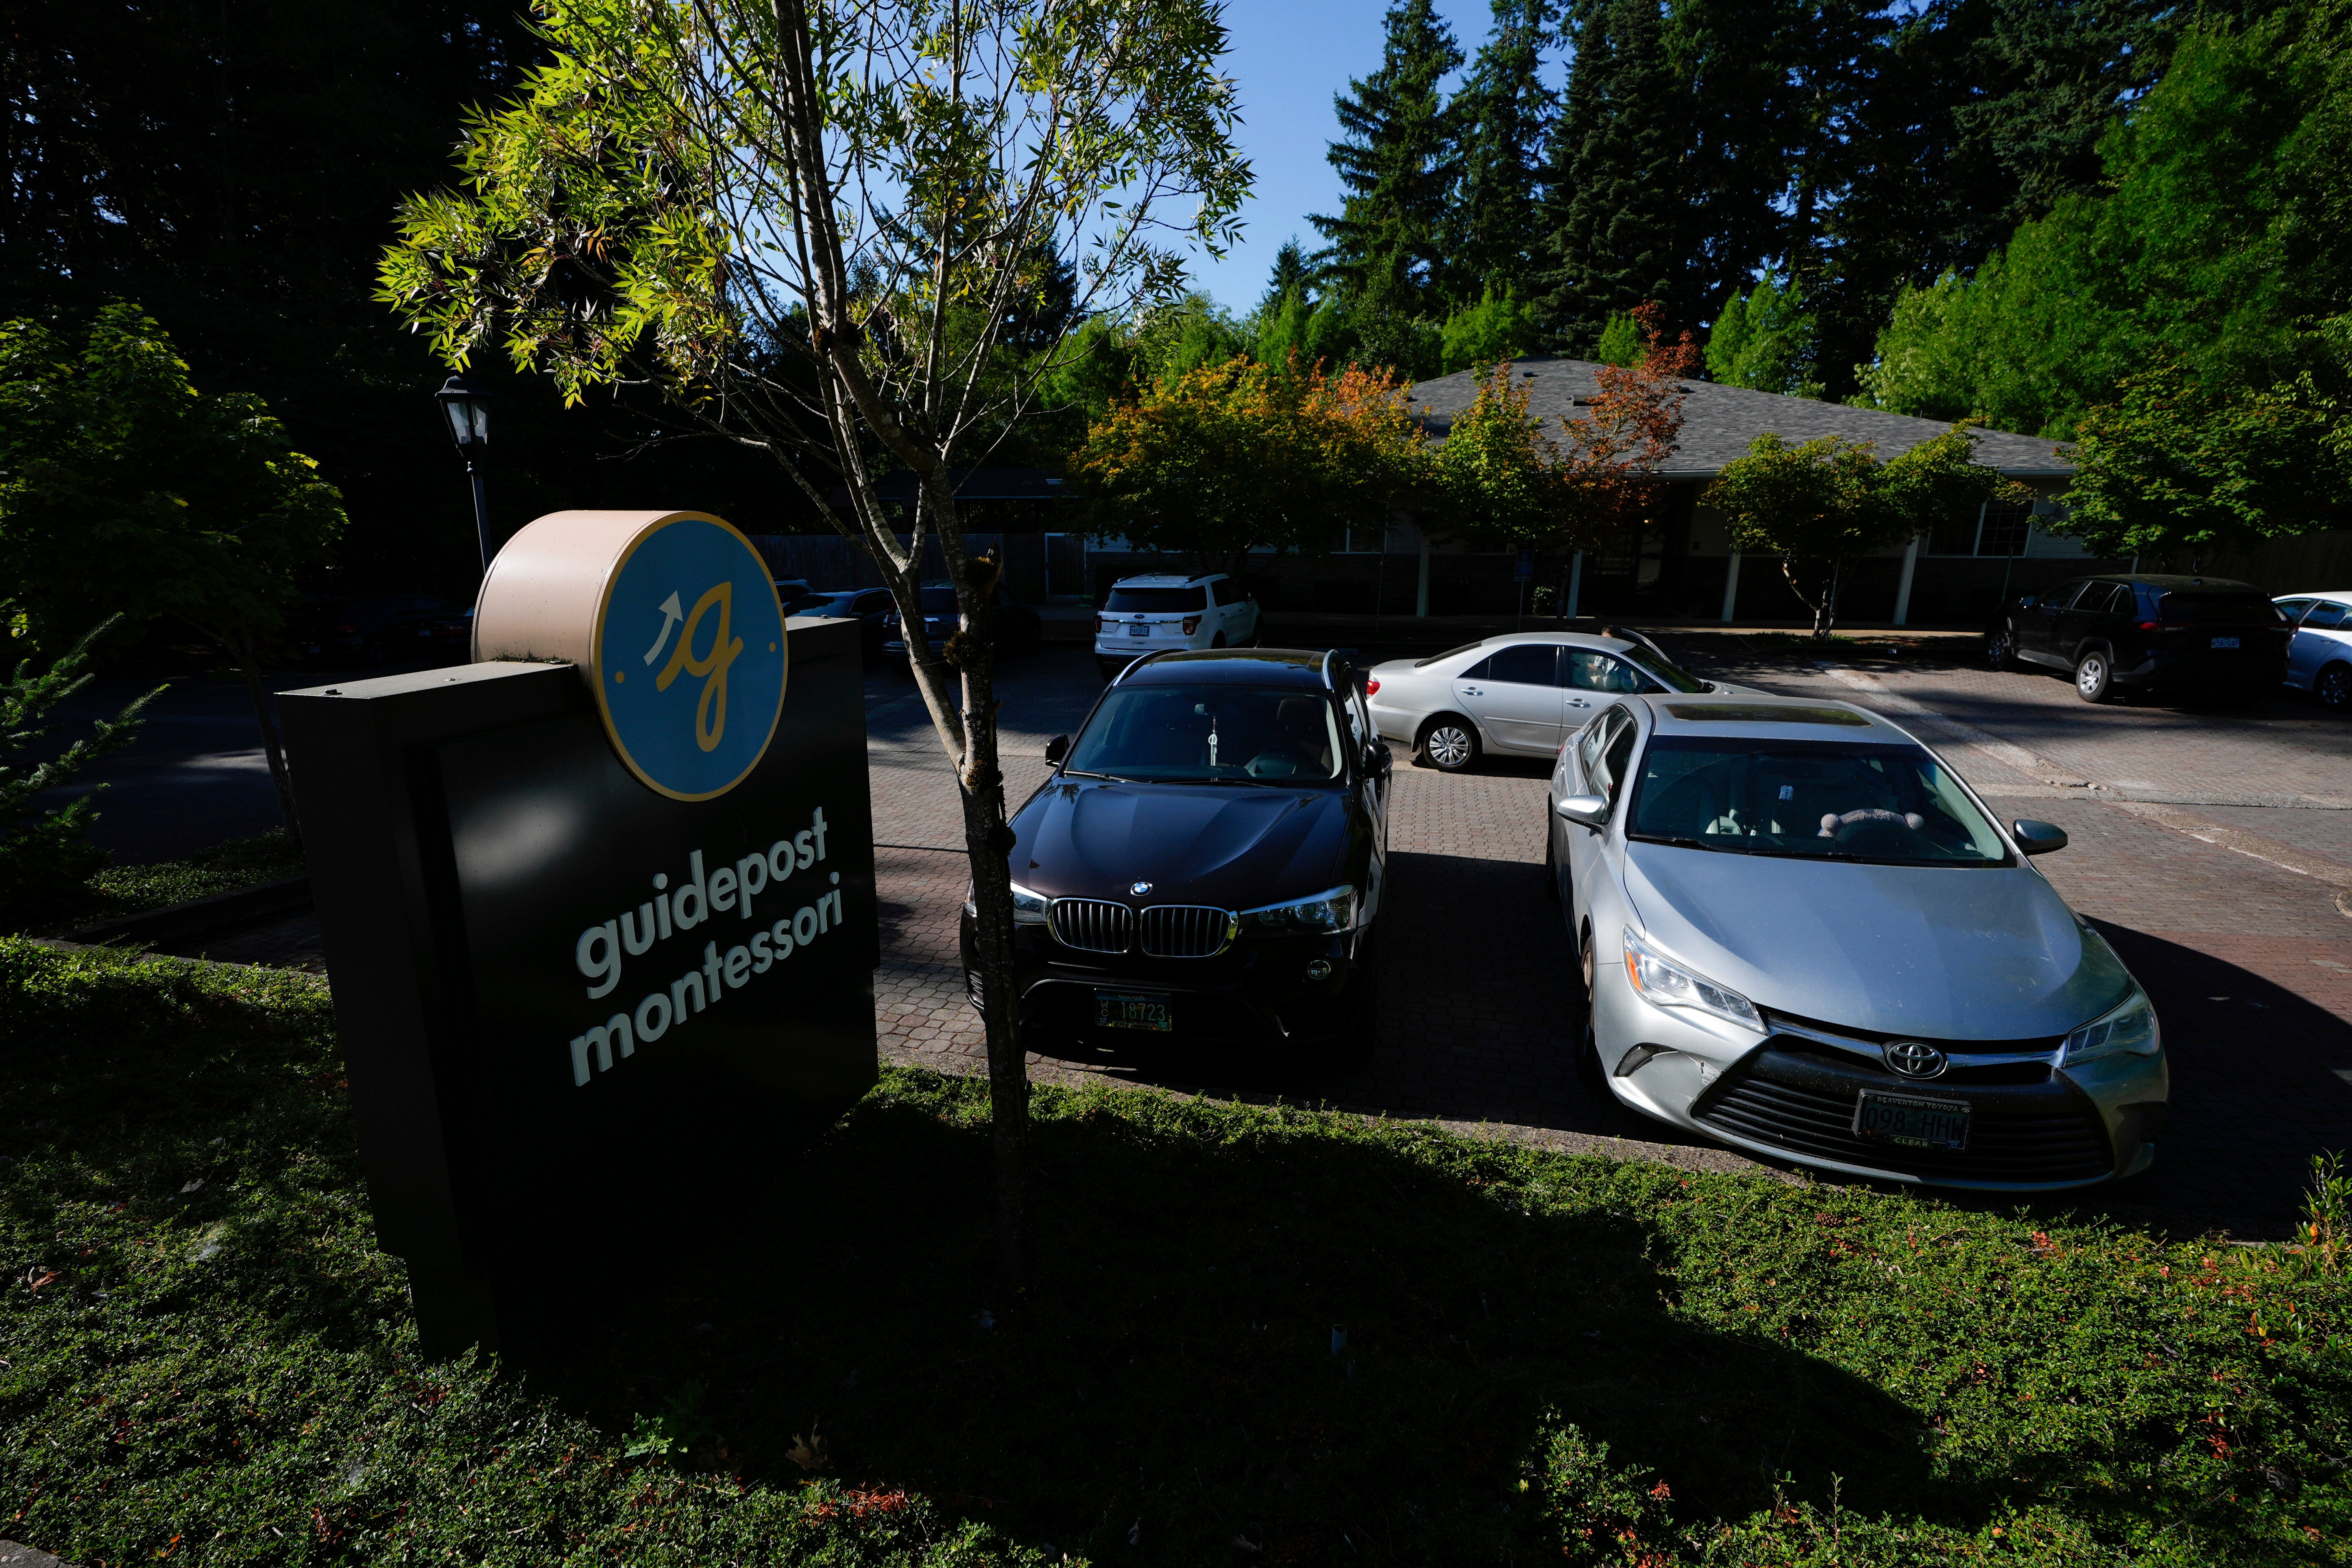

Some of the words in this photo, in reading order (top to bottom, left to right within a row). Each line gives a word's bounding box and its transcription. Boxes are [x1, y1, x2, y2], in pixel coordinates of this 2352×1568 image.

[575, 806, 828, 1000] guidepost
[570, 872, 843, 1087] montessori
[1121, 1001, 1165, 1022] 18723
[1877, 1096, 1925, 1108] BEAVERTON
[1927, 1102, 1959, 1112] TOYOTA
[1866, 1107, 1906, 1132] 098
[1920, 1112, 1965, 1141] HHW
[1894, 1138, 1929, 1147] CLEAR
